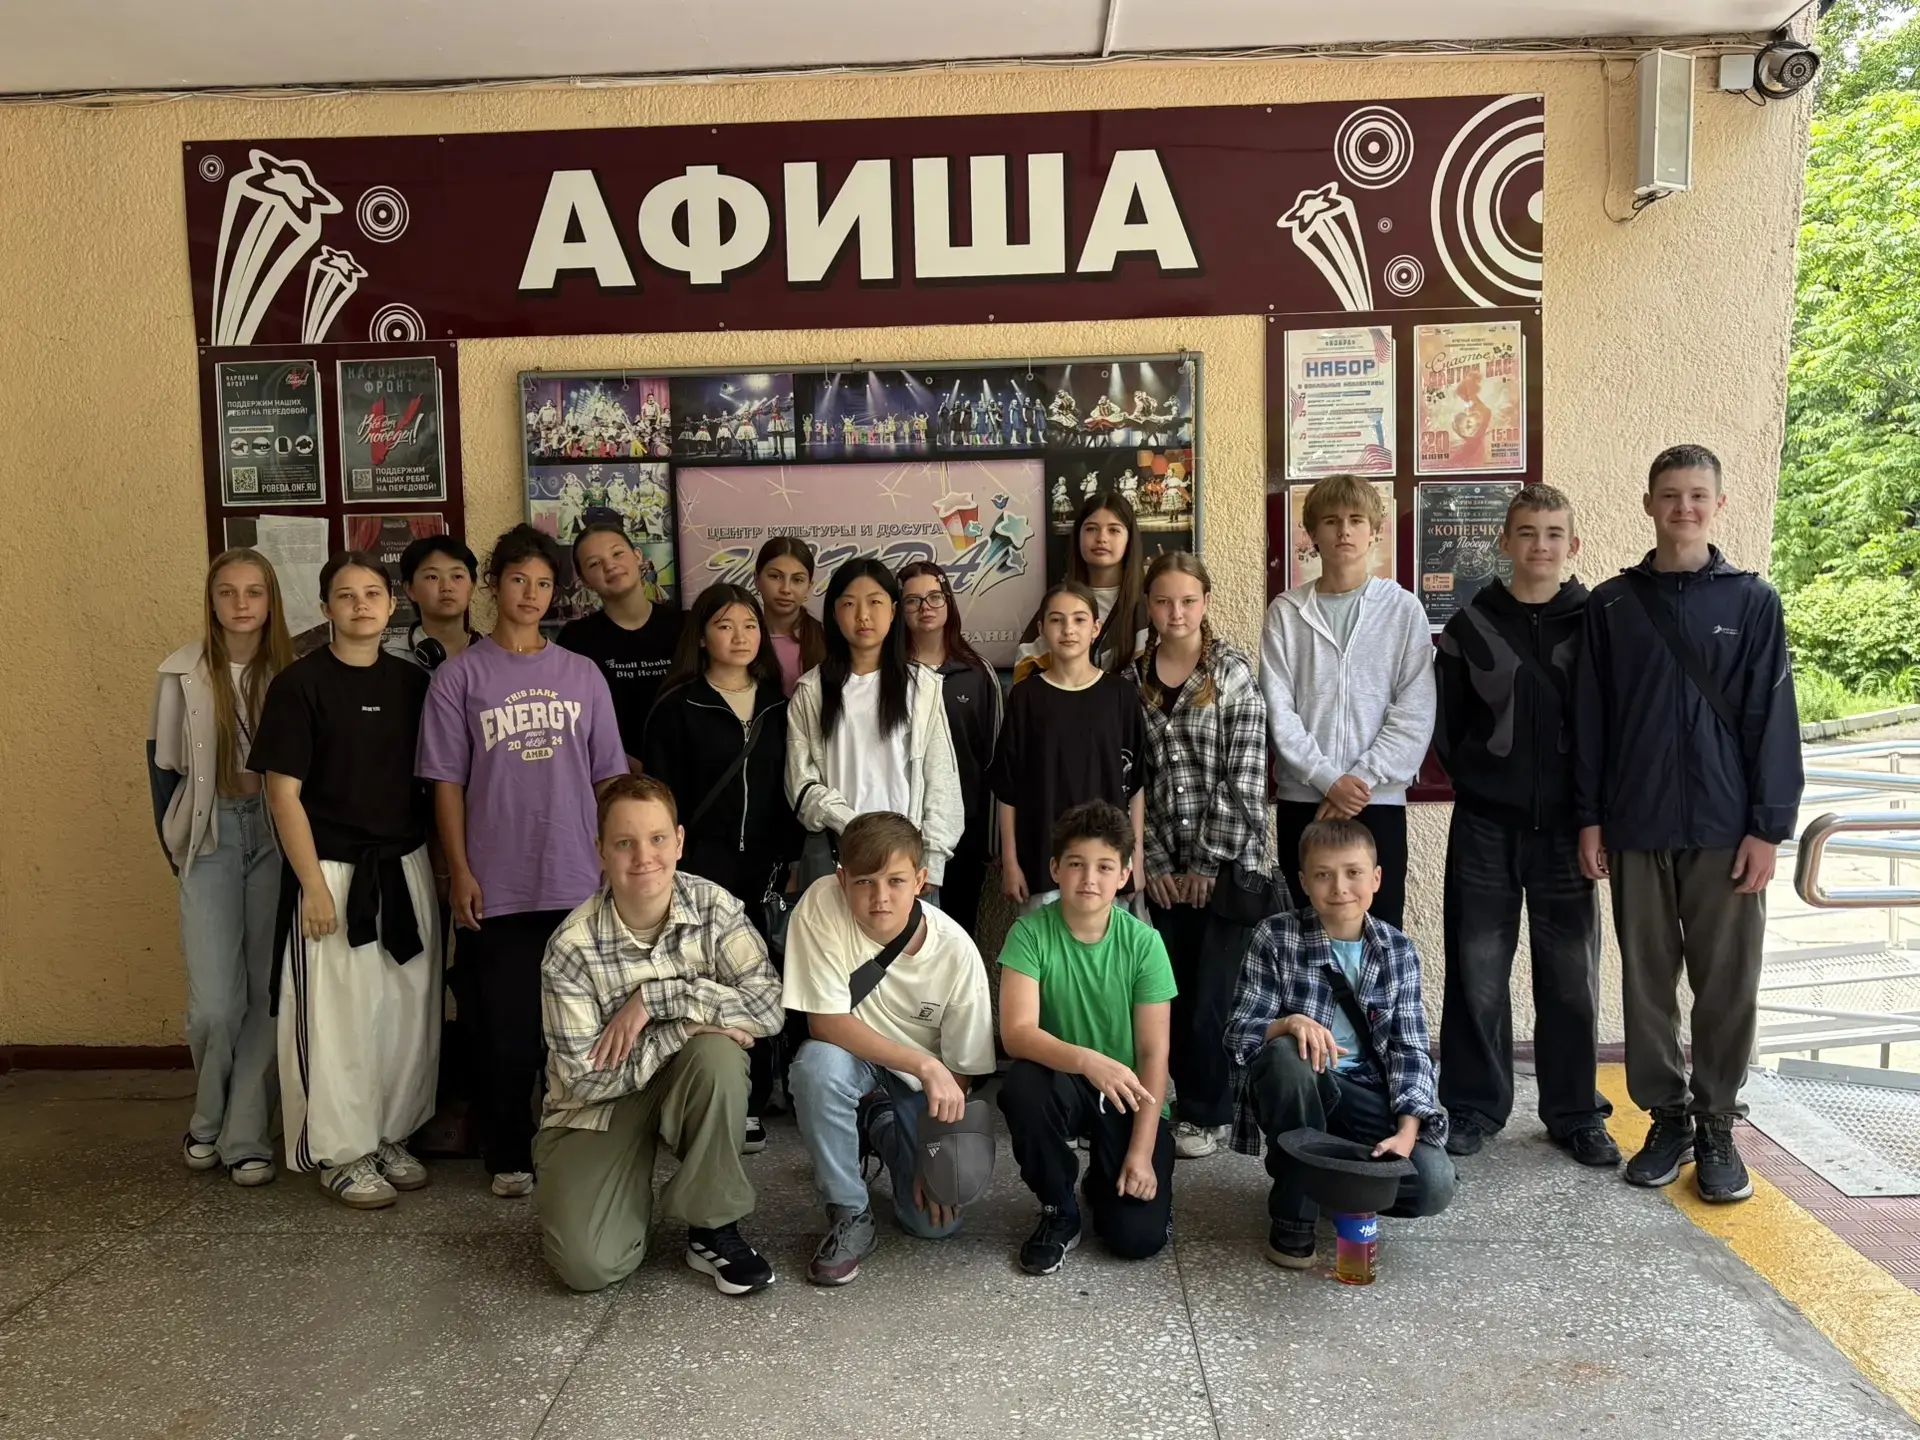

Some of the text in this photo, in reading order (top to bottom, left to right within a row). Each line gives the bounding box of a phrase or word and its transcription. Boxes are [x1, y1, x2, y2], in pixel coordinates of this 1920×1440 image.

[518, 149, 1200, 291] АФИША
[1306, 359, 1375, 377] НАБОР
[1425, 352, 1490, 373] Счастье
[364, 380, 413, 394] ФРОНТ
[227, 400, 274, 408] ПОДДЕРЖИМ
[227, 409, 250, 417] РЕБЯТ
[262, 406, 308, 415] ПЕРЕДОВОЙ!
[1421, 431, 1450, 453] 20
[376, 467, 425, 475] ПОДДЕРЖИМ
[406, 474, 430, 482] РЕБЯТ
[261, 483, 317, 493] POBEDA.ONF.RU
[376, 484, 387, 492] НА
[389, 483, 436, 492] ПЕРЕДОВОЙ!
[706, 520, 944, 541] ЦЕНТР КУЛЬТУРЫ И ДОСУГА
[1427, 524, 1504, 536] «КОПЕЕЧКА
[1438, 536, 1498, 554] за Победу!
[640, 658, 672, 667] Boobs
[616, 668, 668, 679] Big Heart
[504, 688, 559, 704] THIS DARK
[479, 701, 582, 752] ENERGY
[508, 740, 522, 751] 20
[551, 736, 563, 746] 24
[525, 749, 550, 759] AMRA
